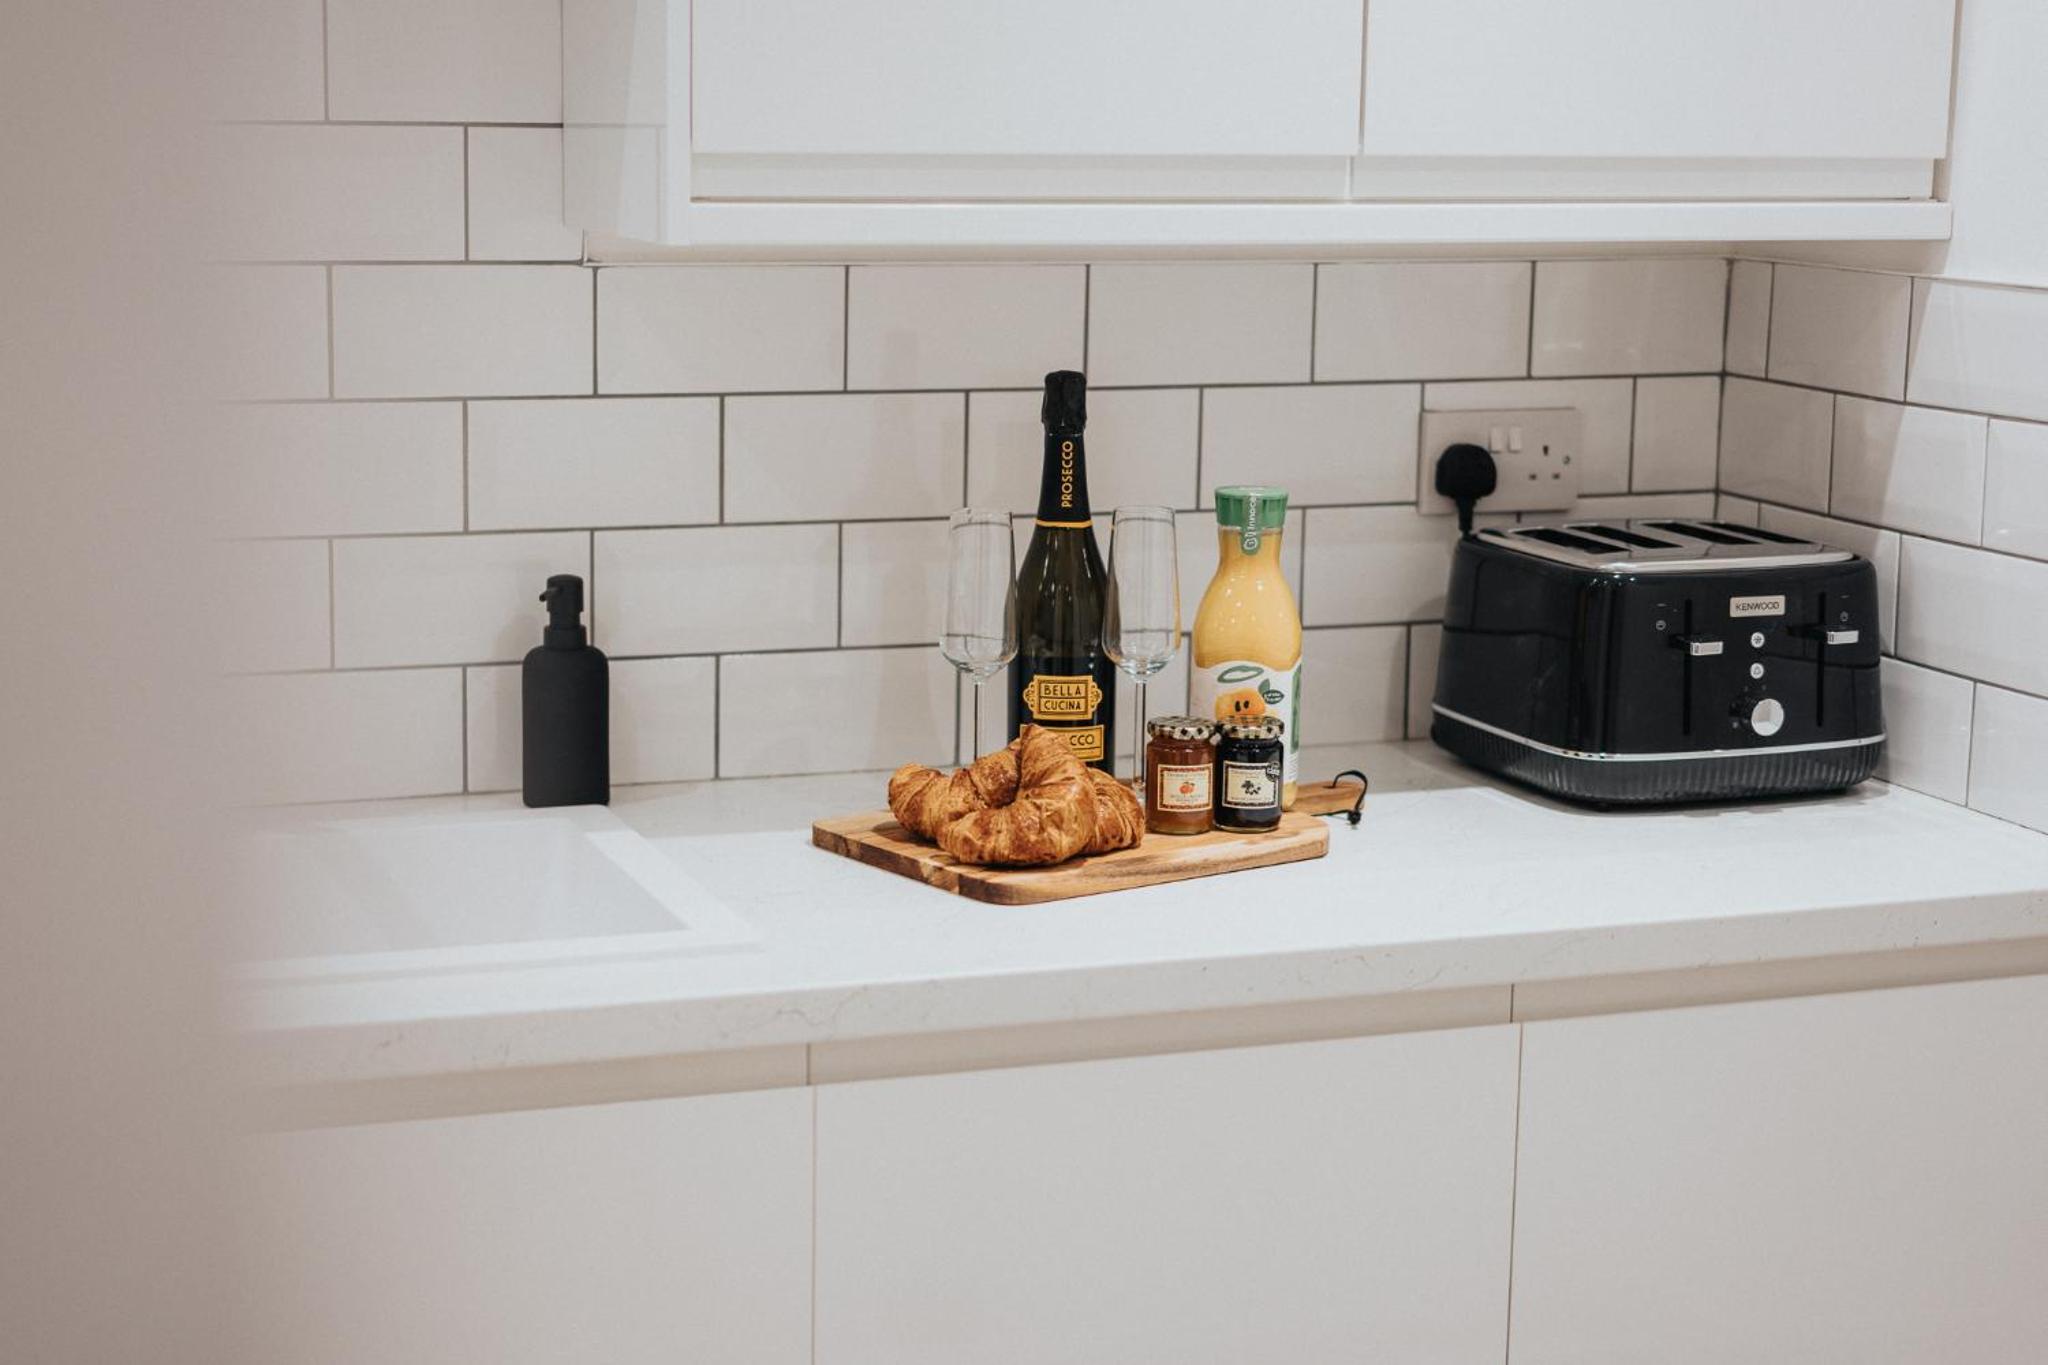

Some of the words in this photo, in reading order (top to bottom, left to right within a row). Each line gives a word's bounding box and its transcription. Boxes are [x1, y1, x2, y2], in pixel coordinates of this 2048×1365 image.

[1061, 440, 1073, 508] PROSECCO
[1734, 601, 1780, 611] KENWOOD
[1043, 684, 1082, 697] BELLA
[1043, 699, 1082, 711] CUCINA
